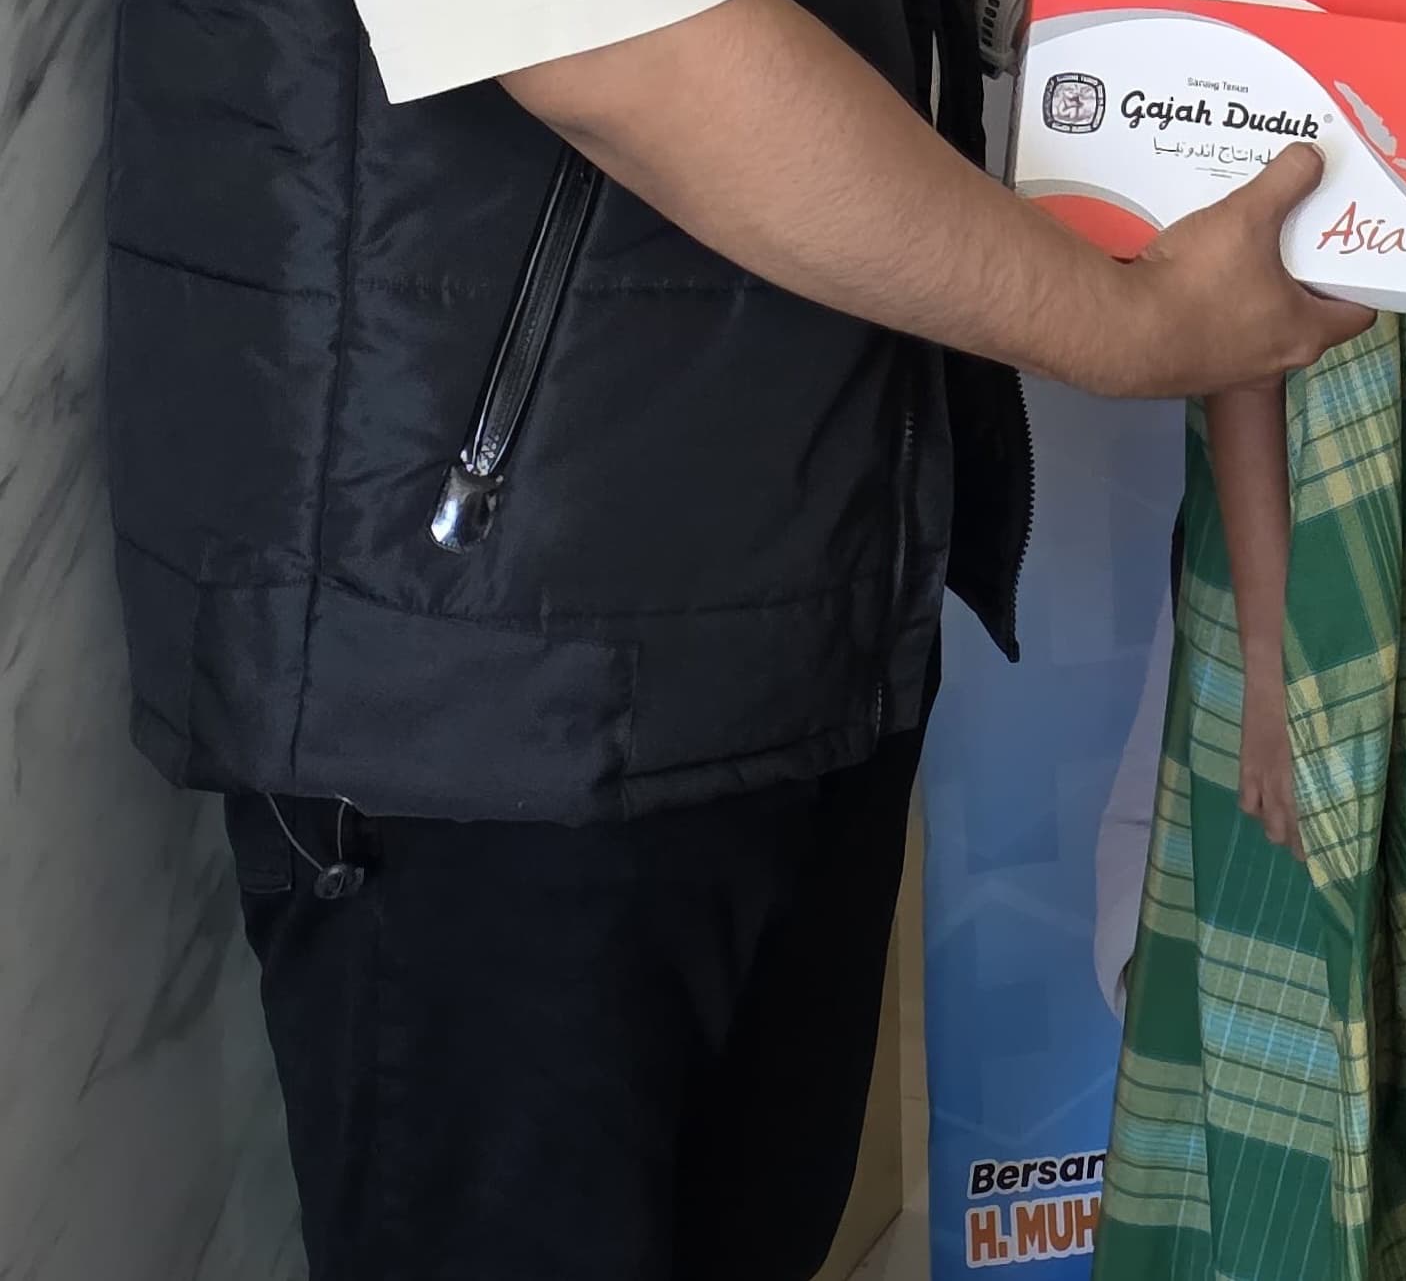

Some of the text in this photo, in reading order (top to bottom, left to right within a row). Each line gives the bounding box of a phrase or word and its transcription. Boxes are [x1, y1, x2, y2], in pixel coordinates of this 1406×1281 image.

[1187, 77, 1249, 94] Sarung Tenun
[1121, 90, 1212, 131] Gajah
[1222, 101, 1319, 139] Duduk
[971, 1210, 1008, 1262] H.
